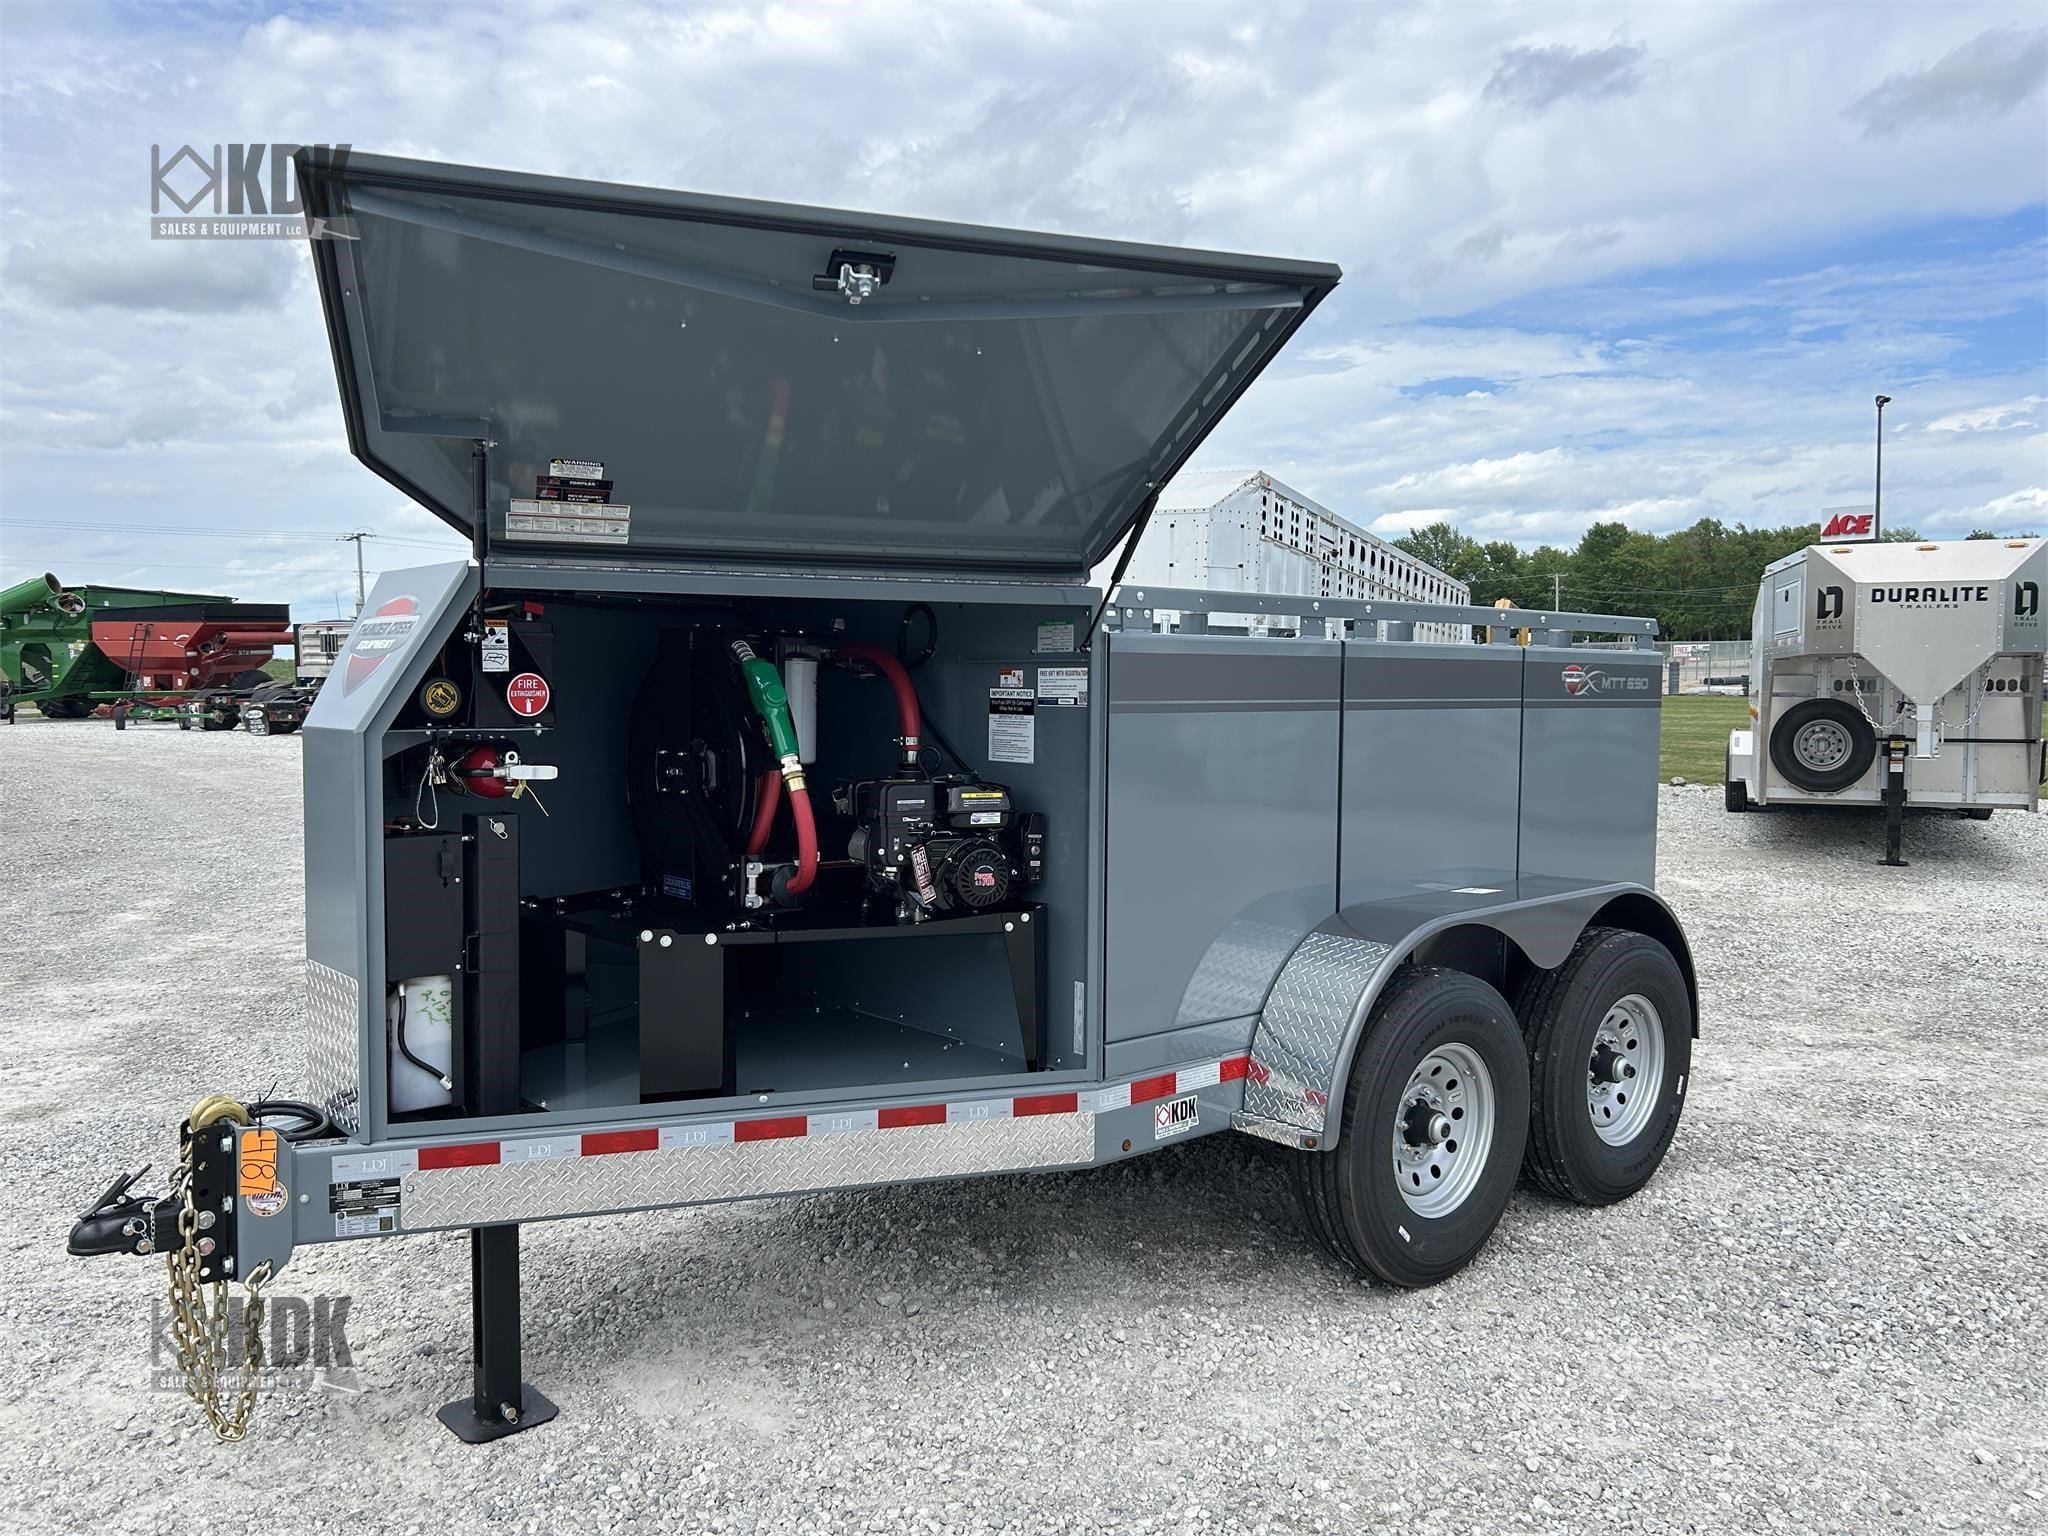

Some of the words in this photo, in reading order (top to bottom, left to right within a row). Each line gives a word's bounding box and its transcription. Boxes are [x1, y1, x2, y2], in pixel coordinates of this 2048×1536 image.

[563, 459, 601, 467] WARNING
[1821, 513, 1874, 536] ACE
[1871, 586, 1989, 603] DURALITE
[517, 679, 539, 689] FIRE
[1601, 677, 1626, 689] MTT
[1627, 677, 1649, 690] 690
[510, 690, 546, 698] EXTINGUISHER
[1016, 690, 1033, 698] NOTICE
[1171, 1097, 1197, 1124] KDK
[527, 1144, 552, 1157] LDJ
[240, 1138, 277, 1193] 4787
[361, 1159, 387, 1173] LDJ
